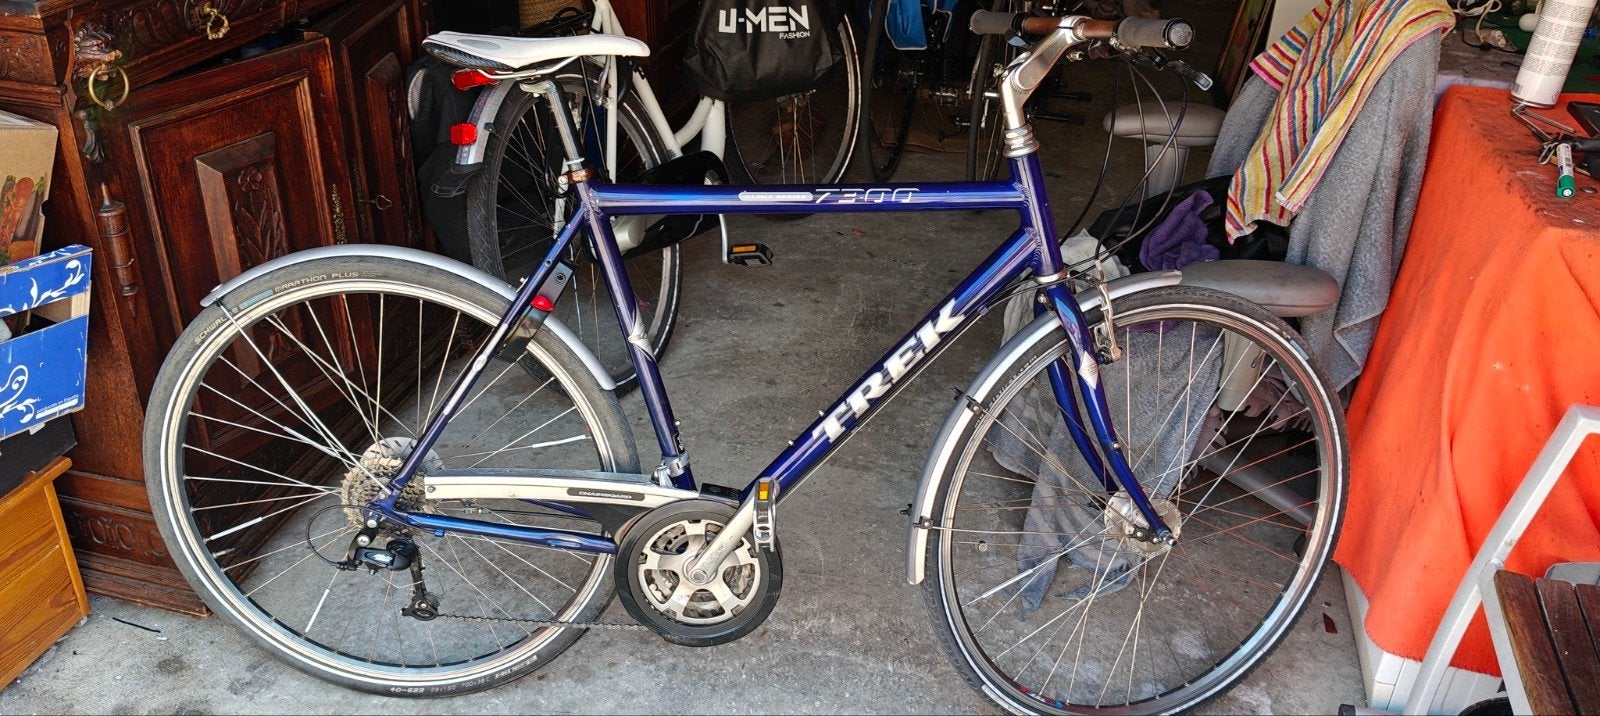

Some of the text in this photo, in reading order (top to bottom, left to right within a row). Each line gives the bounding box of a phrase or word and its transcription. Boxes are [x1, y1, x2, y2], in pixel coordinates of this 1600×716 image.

[718, 5, 809, 33] U-MEN
[779, 31, 810, 40] FASHION
[815, 188, 920, 203] 7300
[194, 306, 239, 345] SCHWALE
[275, 274, 327, 293] MARATHON
[332, 271, 358, 279] PLUS
[812, 298, 965, 443] TREK
[579, 491, 632, 499] CHAINBOARD
